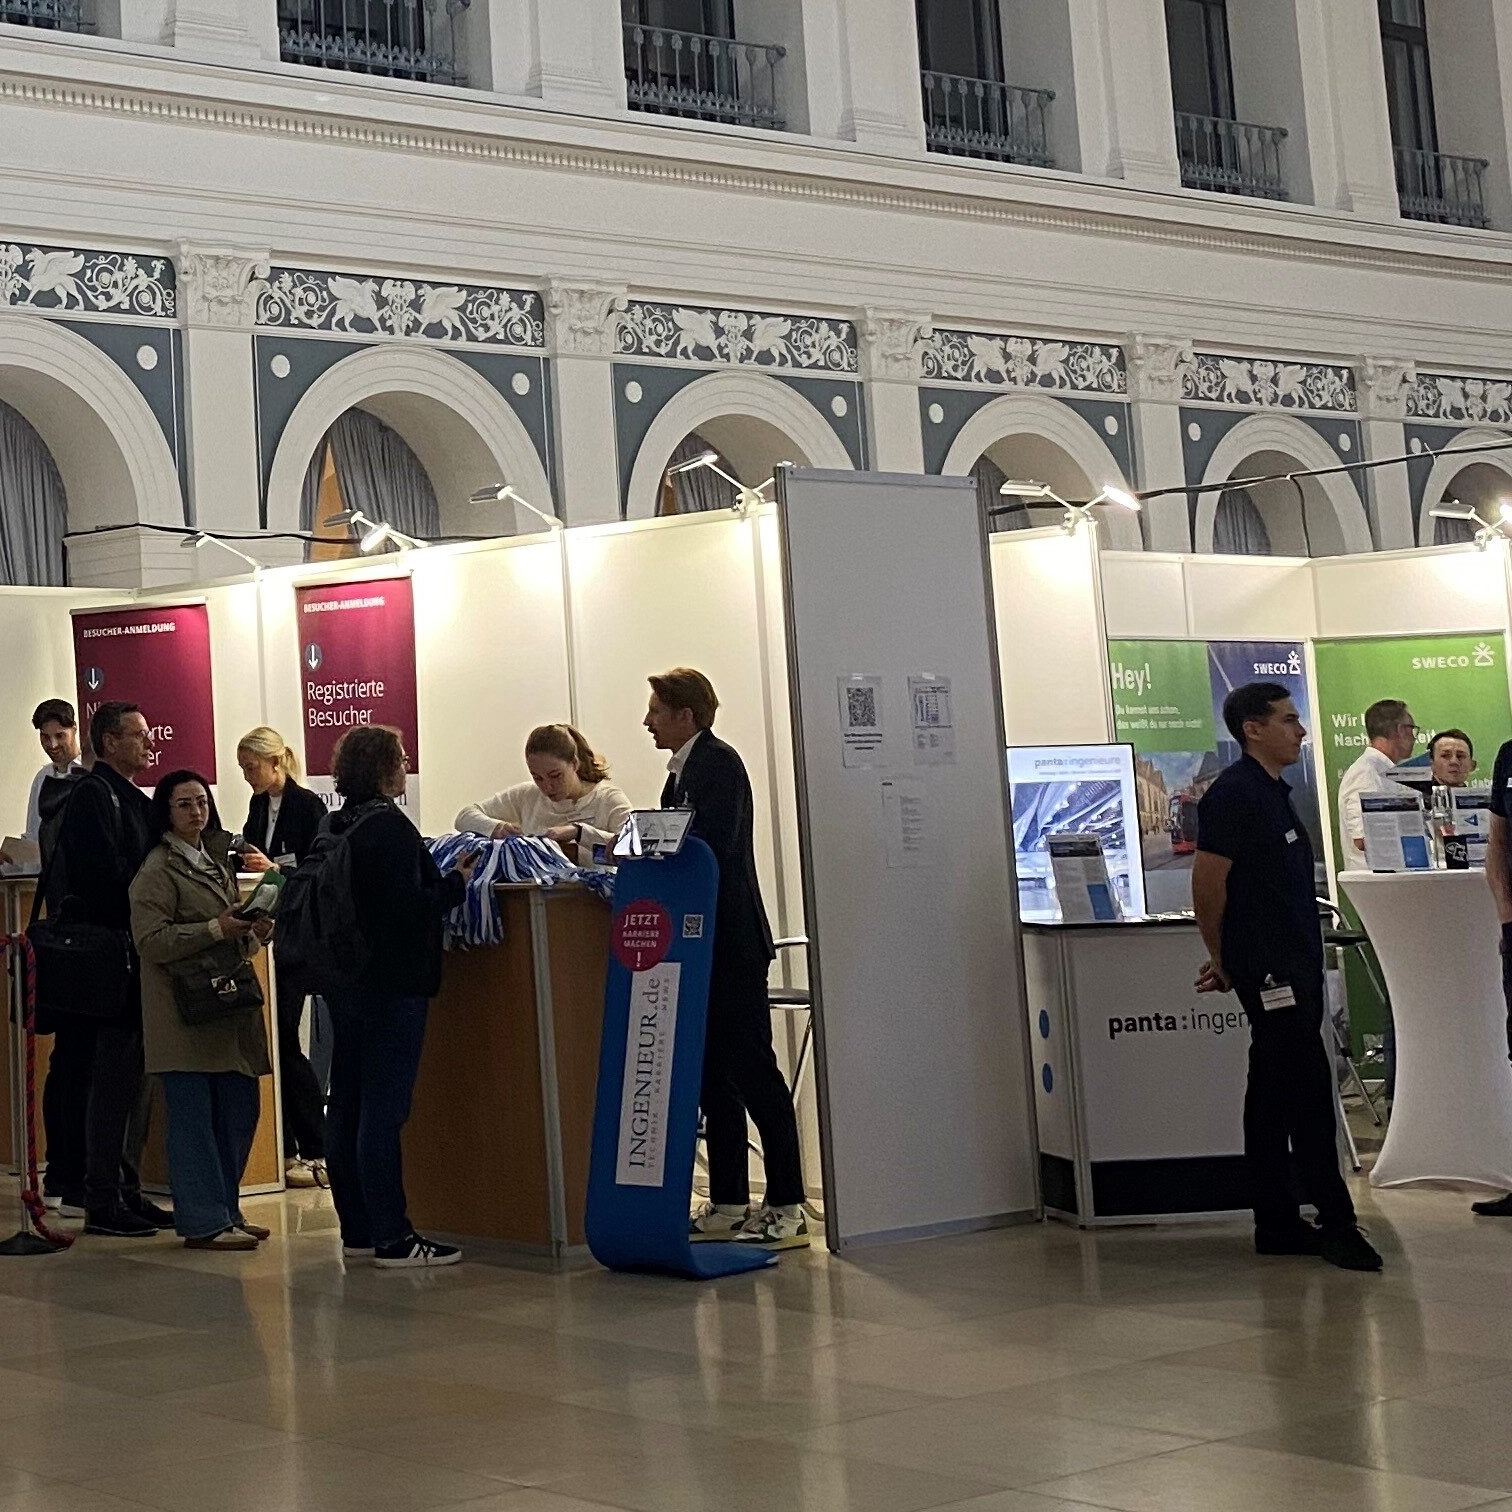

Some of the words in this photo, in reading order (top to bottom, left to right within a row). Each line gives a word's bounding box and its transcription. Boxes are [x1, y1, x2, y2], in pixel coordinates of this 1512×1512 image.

[83, 622, 176, 638] BESUCHER-ANMELDUNG
[1253, 662, 1288, 675] SWECO
[1412, 655, 1470, 669] SWECO
[1111, 662, 1152, 696] Hey!
[307, 679, 385, 705] Registrierte
[308, 705, 374, 727] Besucher
[1332, 713, 1357, 728] Wir
[623, 914, 660, 928] JETZT
[622, 930, 660, 938] KARRIERE
[623, 940, 657, 948] MACHEN
[629, 978, 661, 1168] INGENIEUR.de
